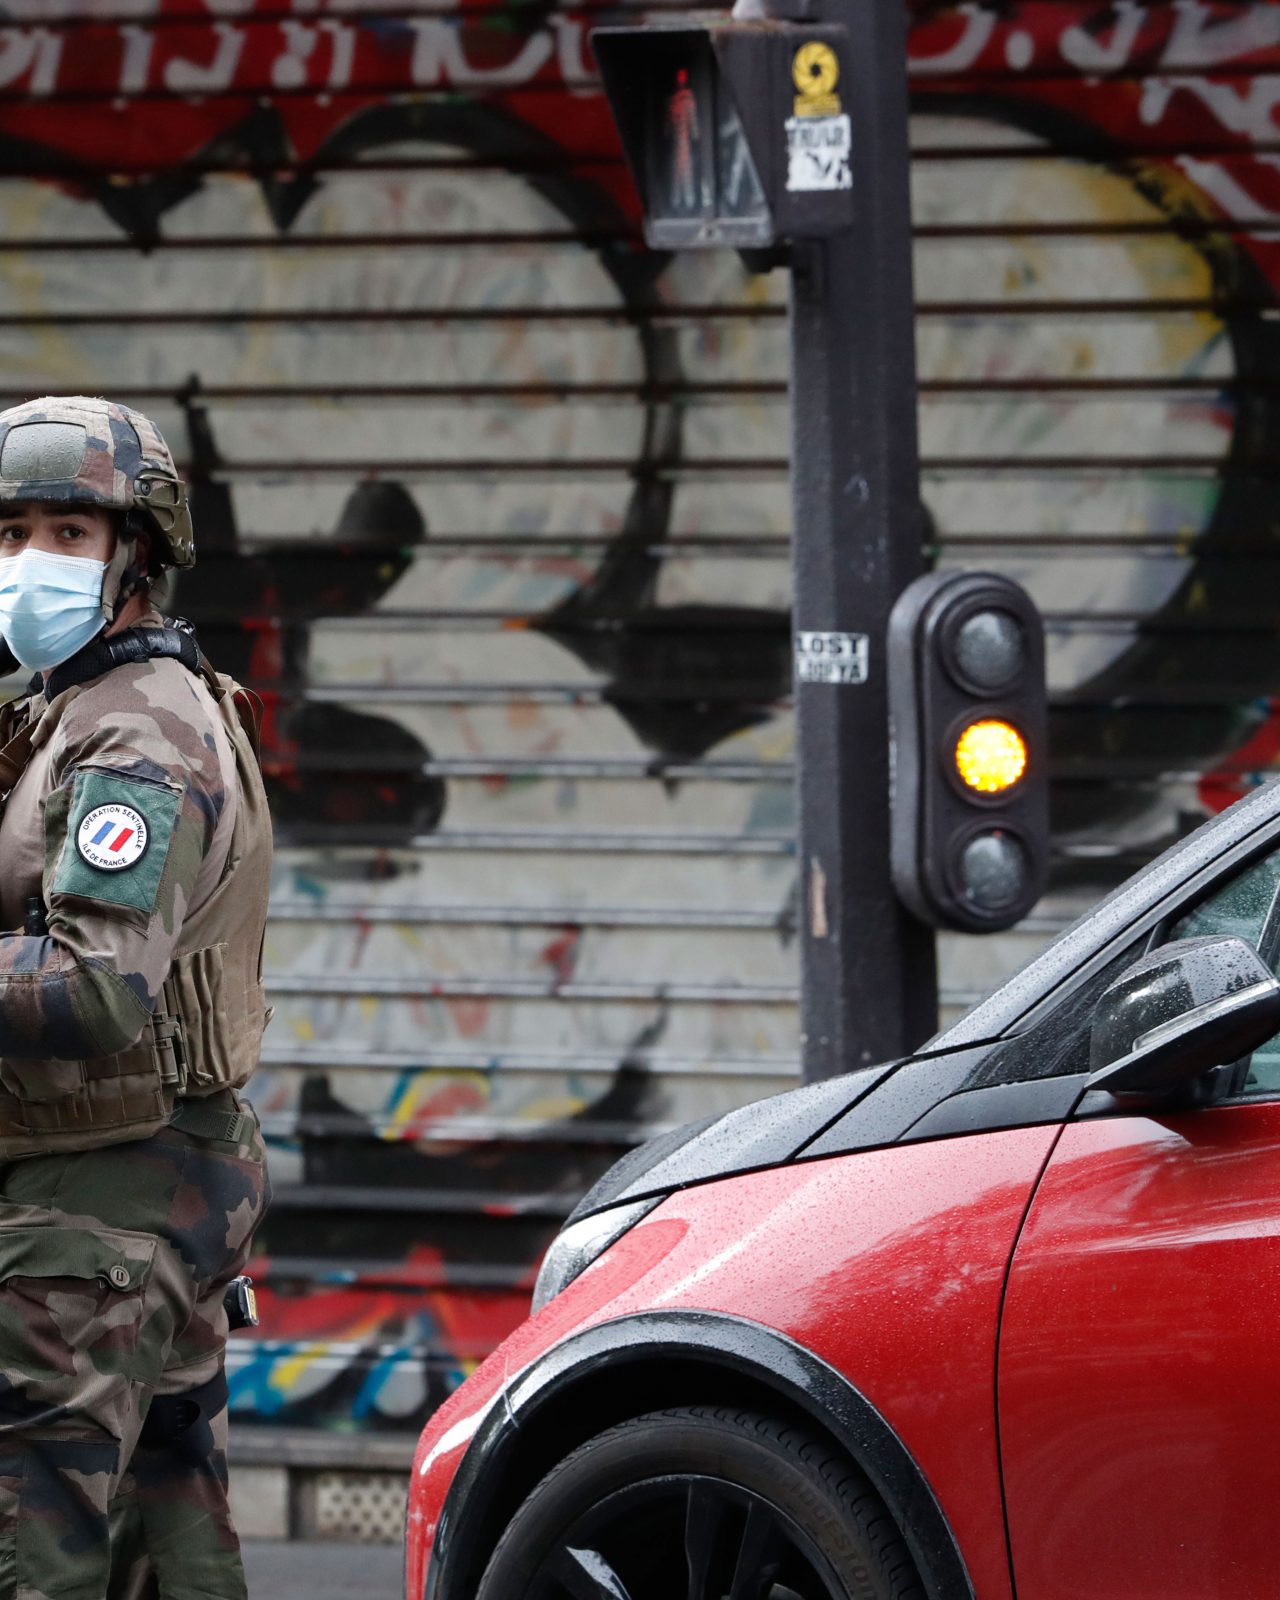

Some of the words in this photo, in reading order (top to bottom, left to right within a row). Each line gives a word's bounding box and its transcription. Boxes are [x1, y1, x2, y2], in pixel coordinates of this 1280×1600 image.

[83, 807, 120, 830] OPÉRATION
[122, 809, 144, 849] SENTINELLE
[89, 853, 99, 862] DE
[99, 857, 127, 866] FRANCE
